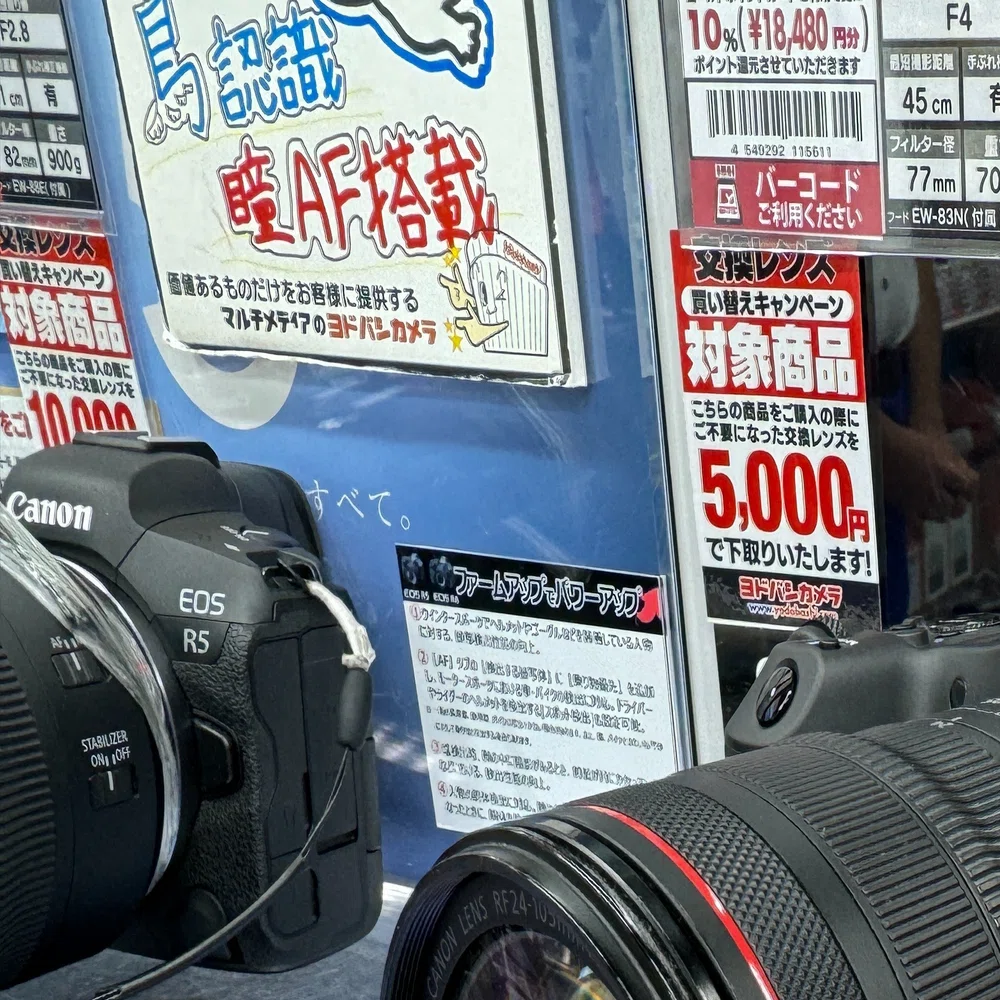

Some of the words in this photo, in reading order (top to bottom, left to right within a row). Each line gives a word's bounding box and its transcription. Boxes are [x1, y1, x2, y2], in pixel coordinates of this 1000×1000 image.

[946, 2, 973, 32] F4
[693, 55, 861, 76] ポイント還元させていただきます
[890, 135, 955, 154] フィルター径
[48, 148, 82, 175] 900g
[222, 127, 494, 249] 瞳AF搭載
[755, 165, 861, 200] バーコード
[907, 165, 956, 193] 77mm
[757, 201, 863, 231] ご利用ください
[167, 271, 419, 313] 価値あるものだけをお客様に提供する
[691, 288, 845, 319] 買い替えキャンペーン
[2, 285, 128, 354] 対象商品
[683, 320, 859, 396] 対象商品
[692, 399, 860, 428] こちらの商品をご購入の際に
[692, 422, 860, 451] ご不要になった交換レンズを
[699, 446, 870, 544] 5,000円
[6, 491, 93, 532] Canon
[179, 588, 225, 615] EOS
[739, 576, 843, 608] ヨドバシカメラ
[183, 629, 209, 654] R5
[81, 730, 129, 753] STABILIZER
[91, 753, 105, 768] ON
[427, 926, 458, 998] CANON
[458, 895, 488, 934] LENS
